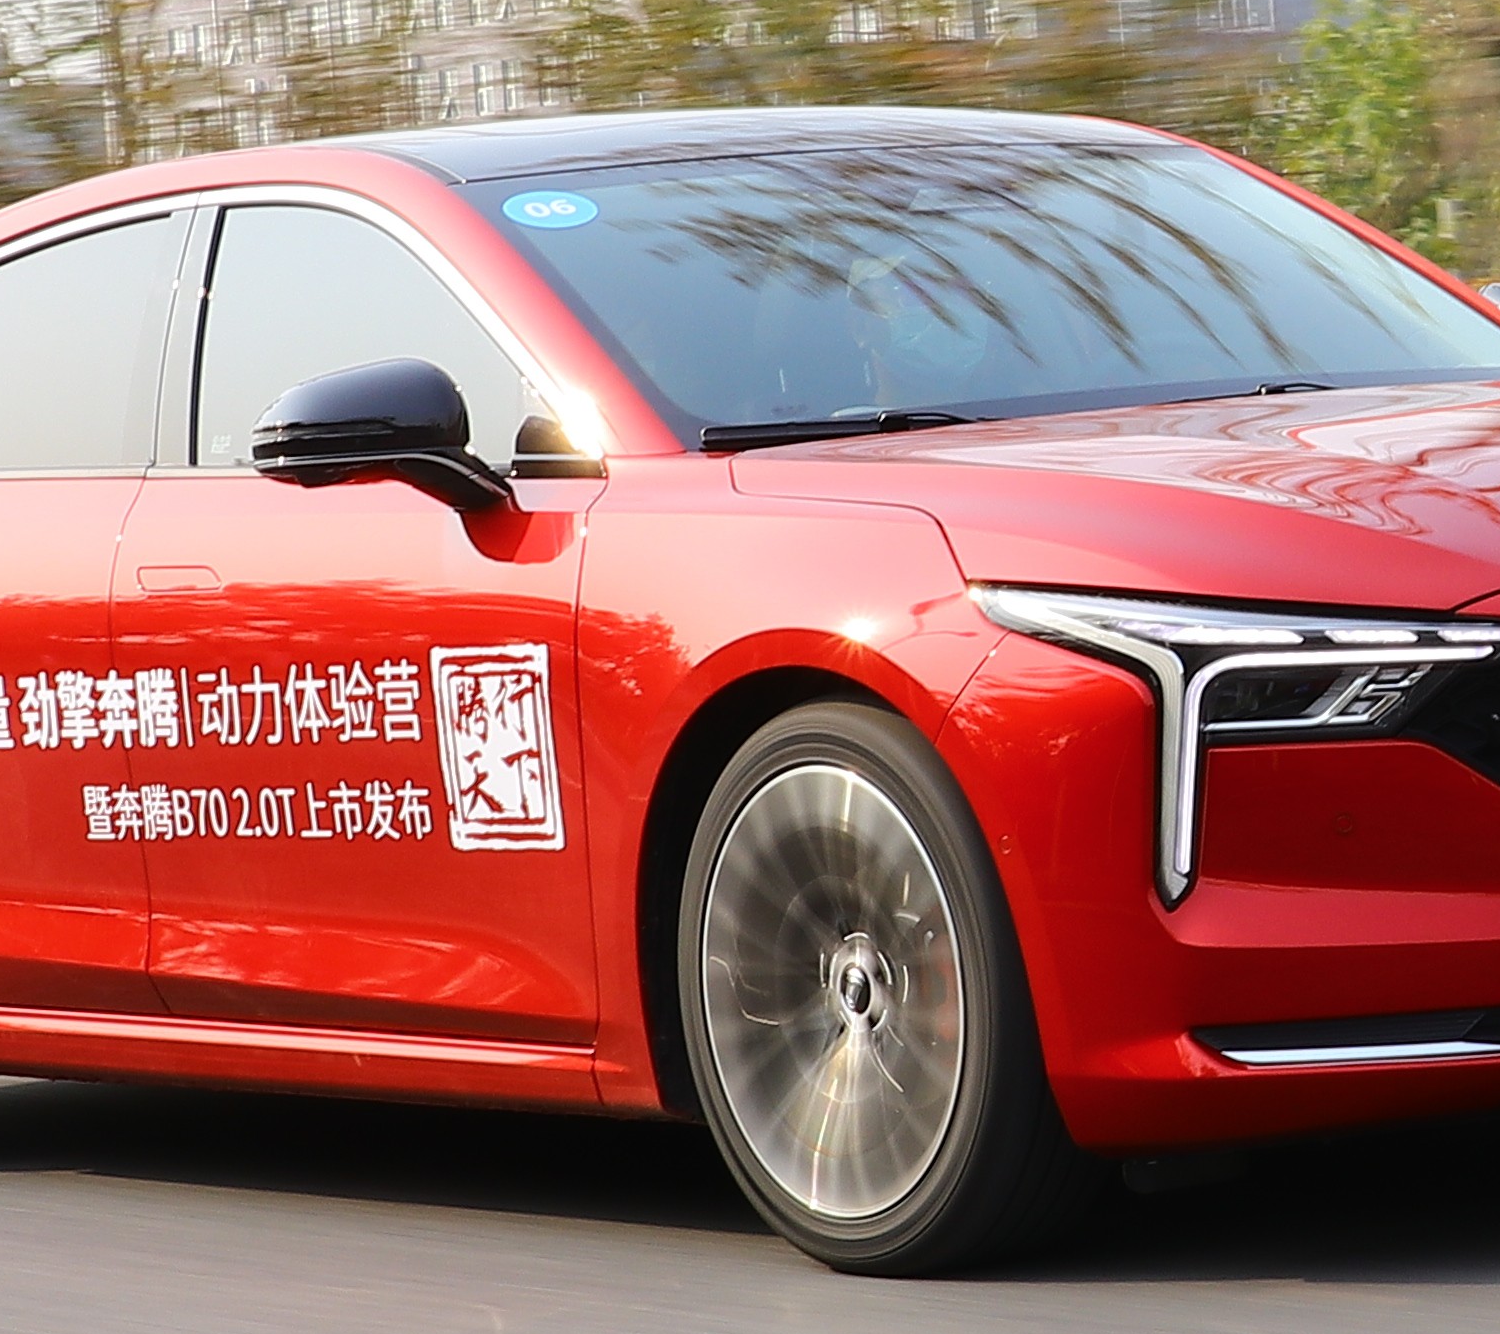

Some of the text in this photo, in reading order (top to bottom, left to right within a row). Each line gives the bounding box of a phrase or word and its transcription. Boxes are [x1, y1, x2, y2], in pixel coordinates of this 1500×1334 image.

[523, 198, 577, 218] 06
[17, 667, 180, 750] 劲擎奔腾
[196, 659, 423, 746] 动力体验营
